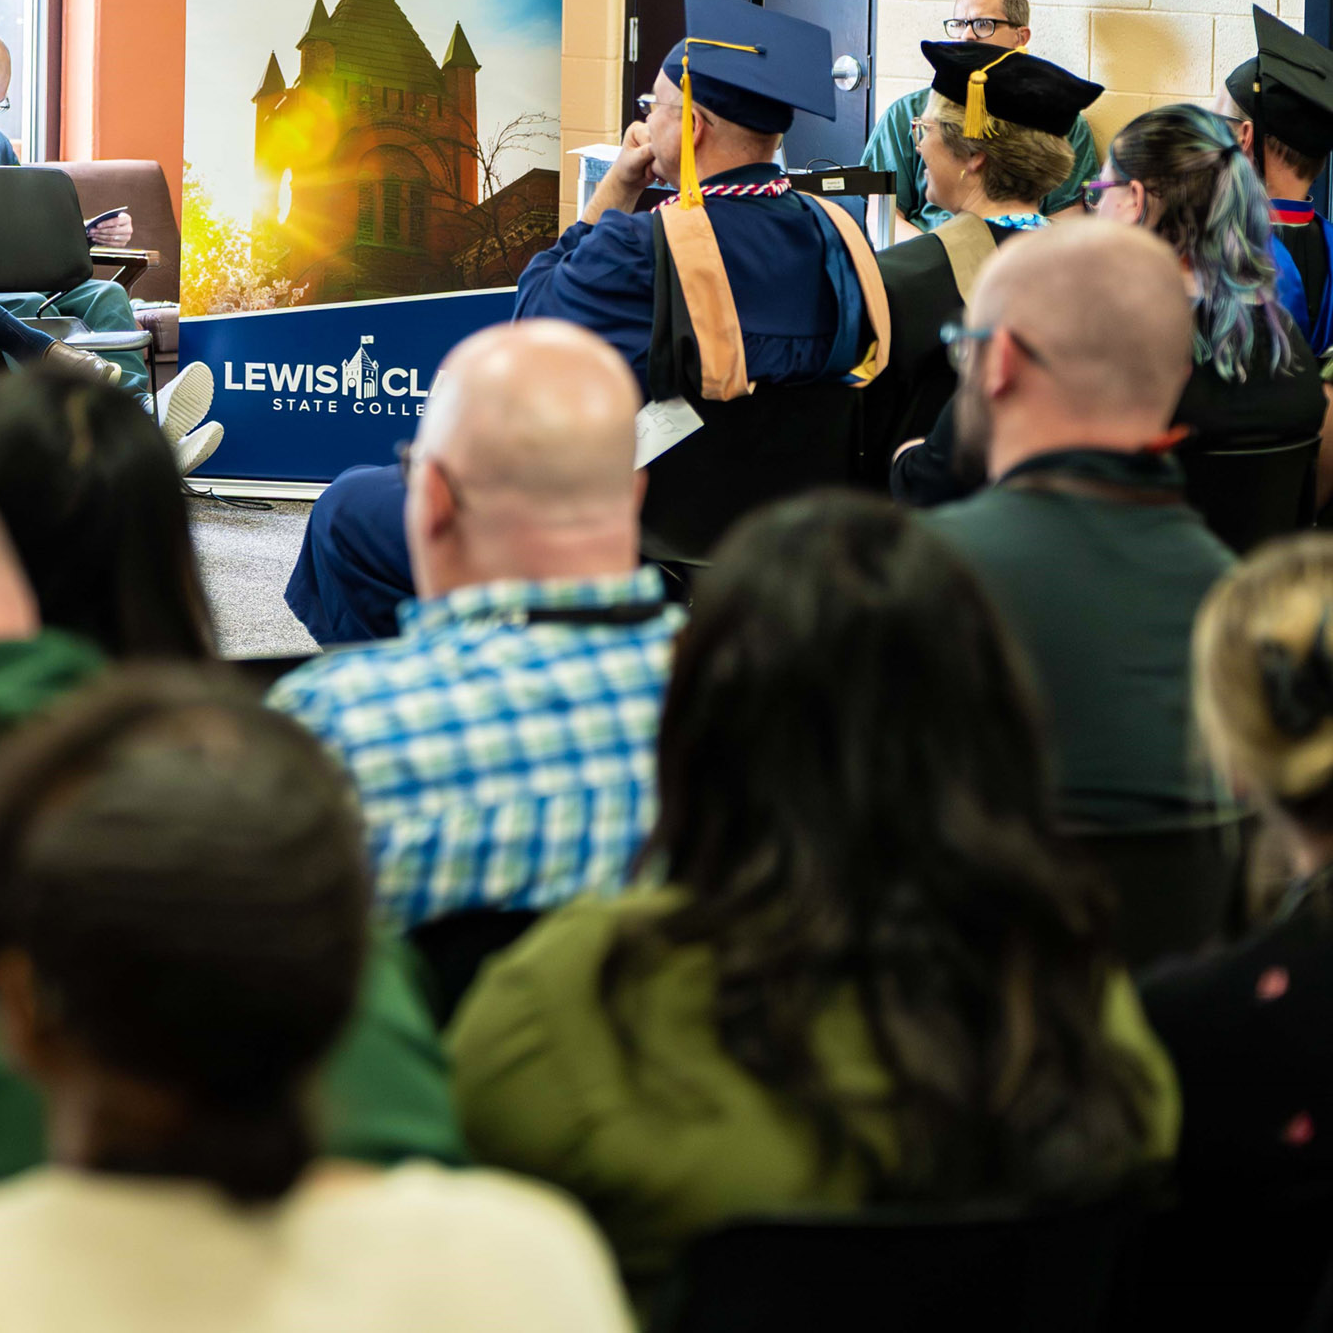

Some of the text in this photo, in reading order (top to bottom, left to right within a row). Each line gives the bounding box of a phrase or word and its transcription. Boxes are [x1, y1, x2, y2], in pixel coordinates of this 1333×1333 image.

[225, 362, 338, 393] LEWIS
[272, 398, 425, 416] STATE COLLE
